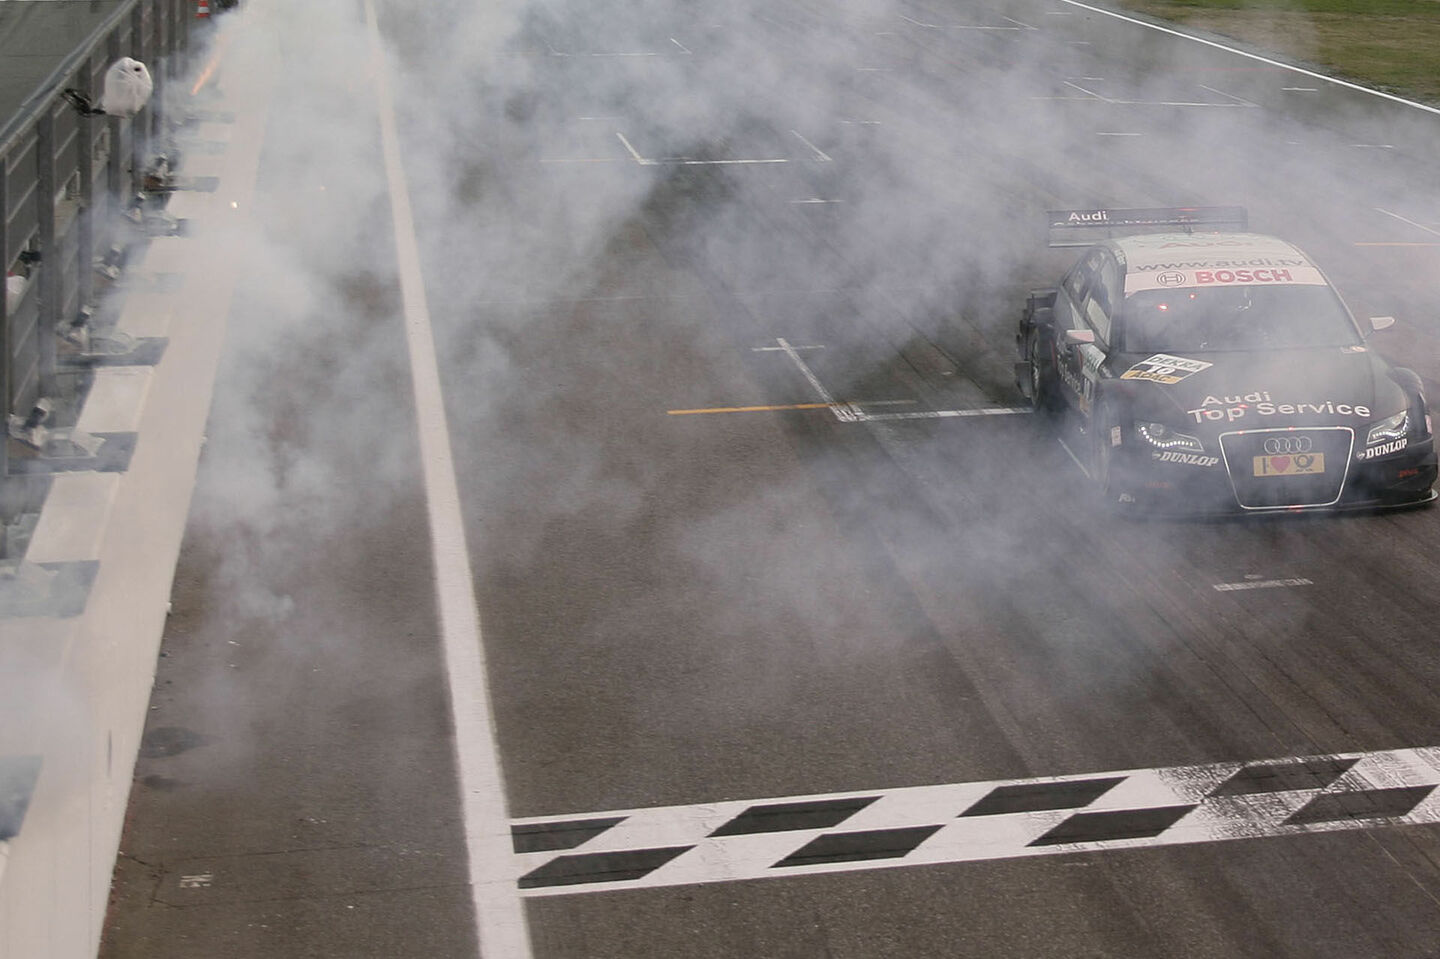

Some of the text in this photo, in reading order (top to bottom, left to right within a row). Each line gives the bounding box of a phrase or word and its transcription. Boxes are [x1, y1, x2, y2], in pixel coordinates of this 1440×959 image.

[1068, 210, 1108, 221] Audi
[1136, 258, 1303, 271] www.audi.tv
[1195, 269, 1293, 284] BOSCH
[1147, 356, 1202, 370] DEKRA
[1201, 391, 1271, 407] Audi
[1187, 401, 1371, 423] Top Service
[1365, 438, 1408, 459] DUNLOP
[1160, 451, 1219, 467] DUNLOP
